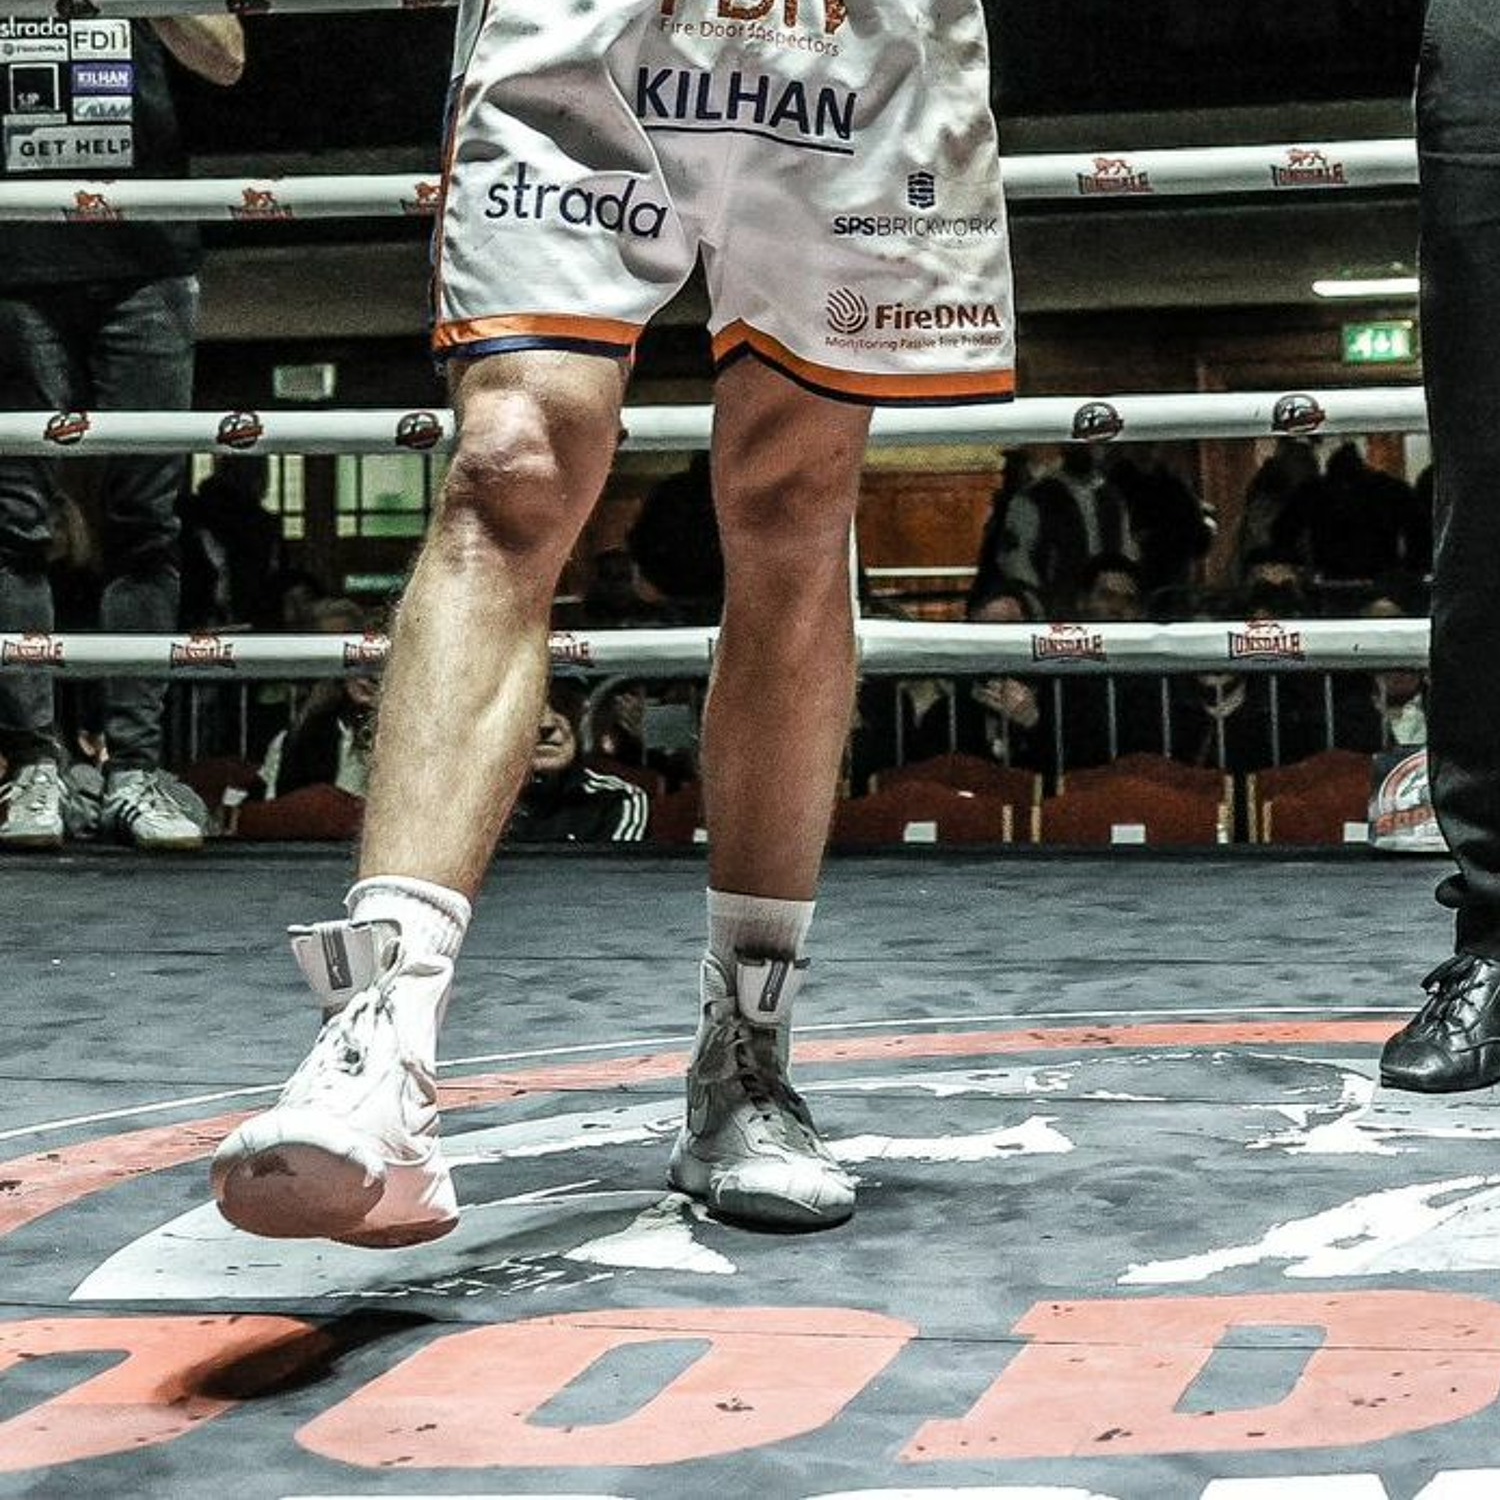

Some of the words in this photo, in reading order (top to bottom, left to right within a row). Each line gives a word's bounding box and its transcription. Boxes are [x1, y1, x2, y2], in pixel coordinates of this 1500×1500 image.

[0, 15, 68, 37] strada
[660, 16, 695, 35] Fire
[700, 20, 743, 38] Door
[636, 67, 857, 140] KILHAN
[21, 140, 65, 156] GET
[75, 139, 131, 154] HELP
[485, 162, 668, 238] strada
[874, 301, 1002, 330] FireDNA
[1032, 635, 1106, 660] LONSDALE
[1228, 630, 1308, 661] LONSDALE
